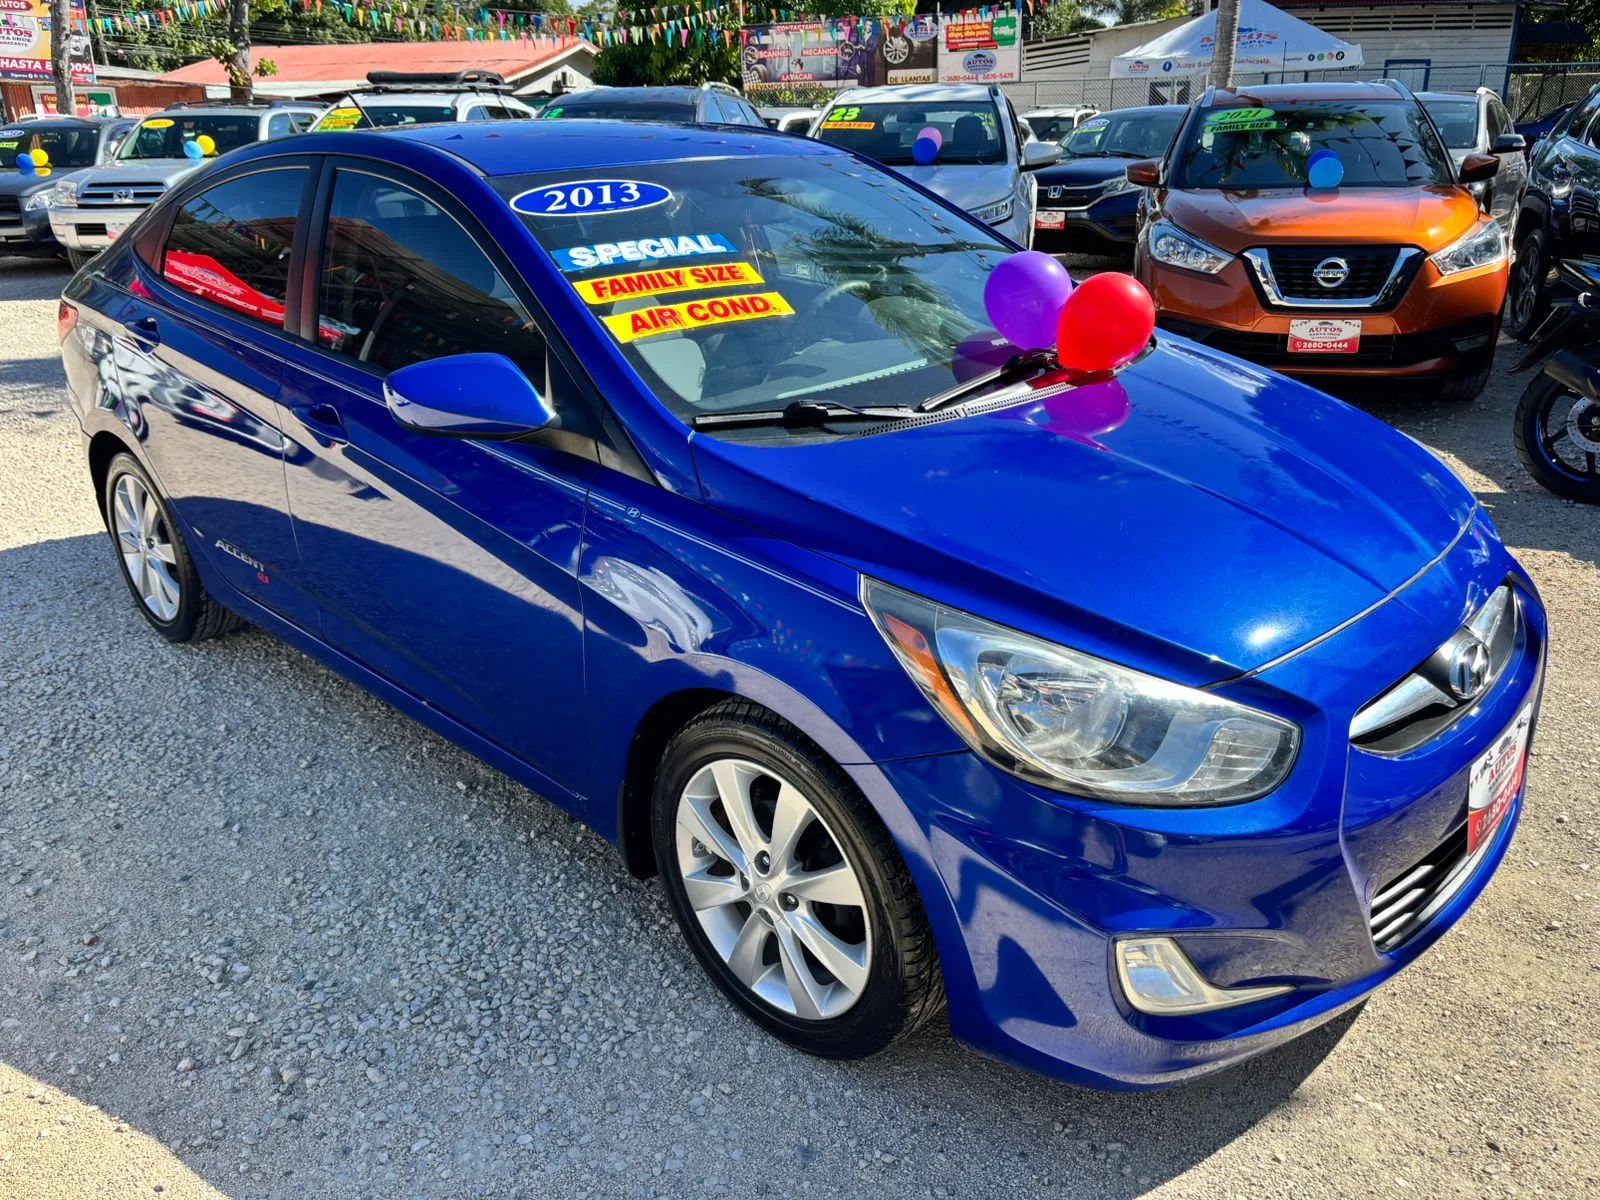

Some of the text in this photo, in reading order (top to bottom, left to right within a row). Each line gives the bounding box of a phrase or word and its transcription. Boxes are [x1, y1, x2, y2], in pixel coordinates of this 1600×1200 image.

[759, 50, 791, 58] SCANNER
[0, 59, 43, 70] HASTA
[967, 58, 994, 66] AUTOS
[781, 73, 813, 81] LAVACAR
[748, 83, 782, 91] LLEVAMOS
[828, 107, 860, 121] 23
[1218, 109, 1263, 121] 2021
[1210, 121, 1273, 132] FAMILY SIZE
[543, 182, 641, 212] 2013
[568, 234, 727, 267] SPECIAL
[1317, 269, 1347, 277] NISSAN
[590, 264, 749, 300] FAMILY SIZE
[630, 296, 780, 334] AIR COND.
[1302, 341, 1349, 349] 2680-0444
[214, 539, 266, 572] ACCENT
[1487, 740, 1518, 785] AUTOS
